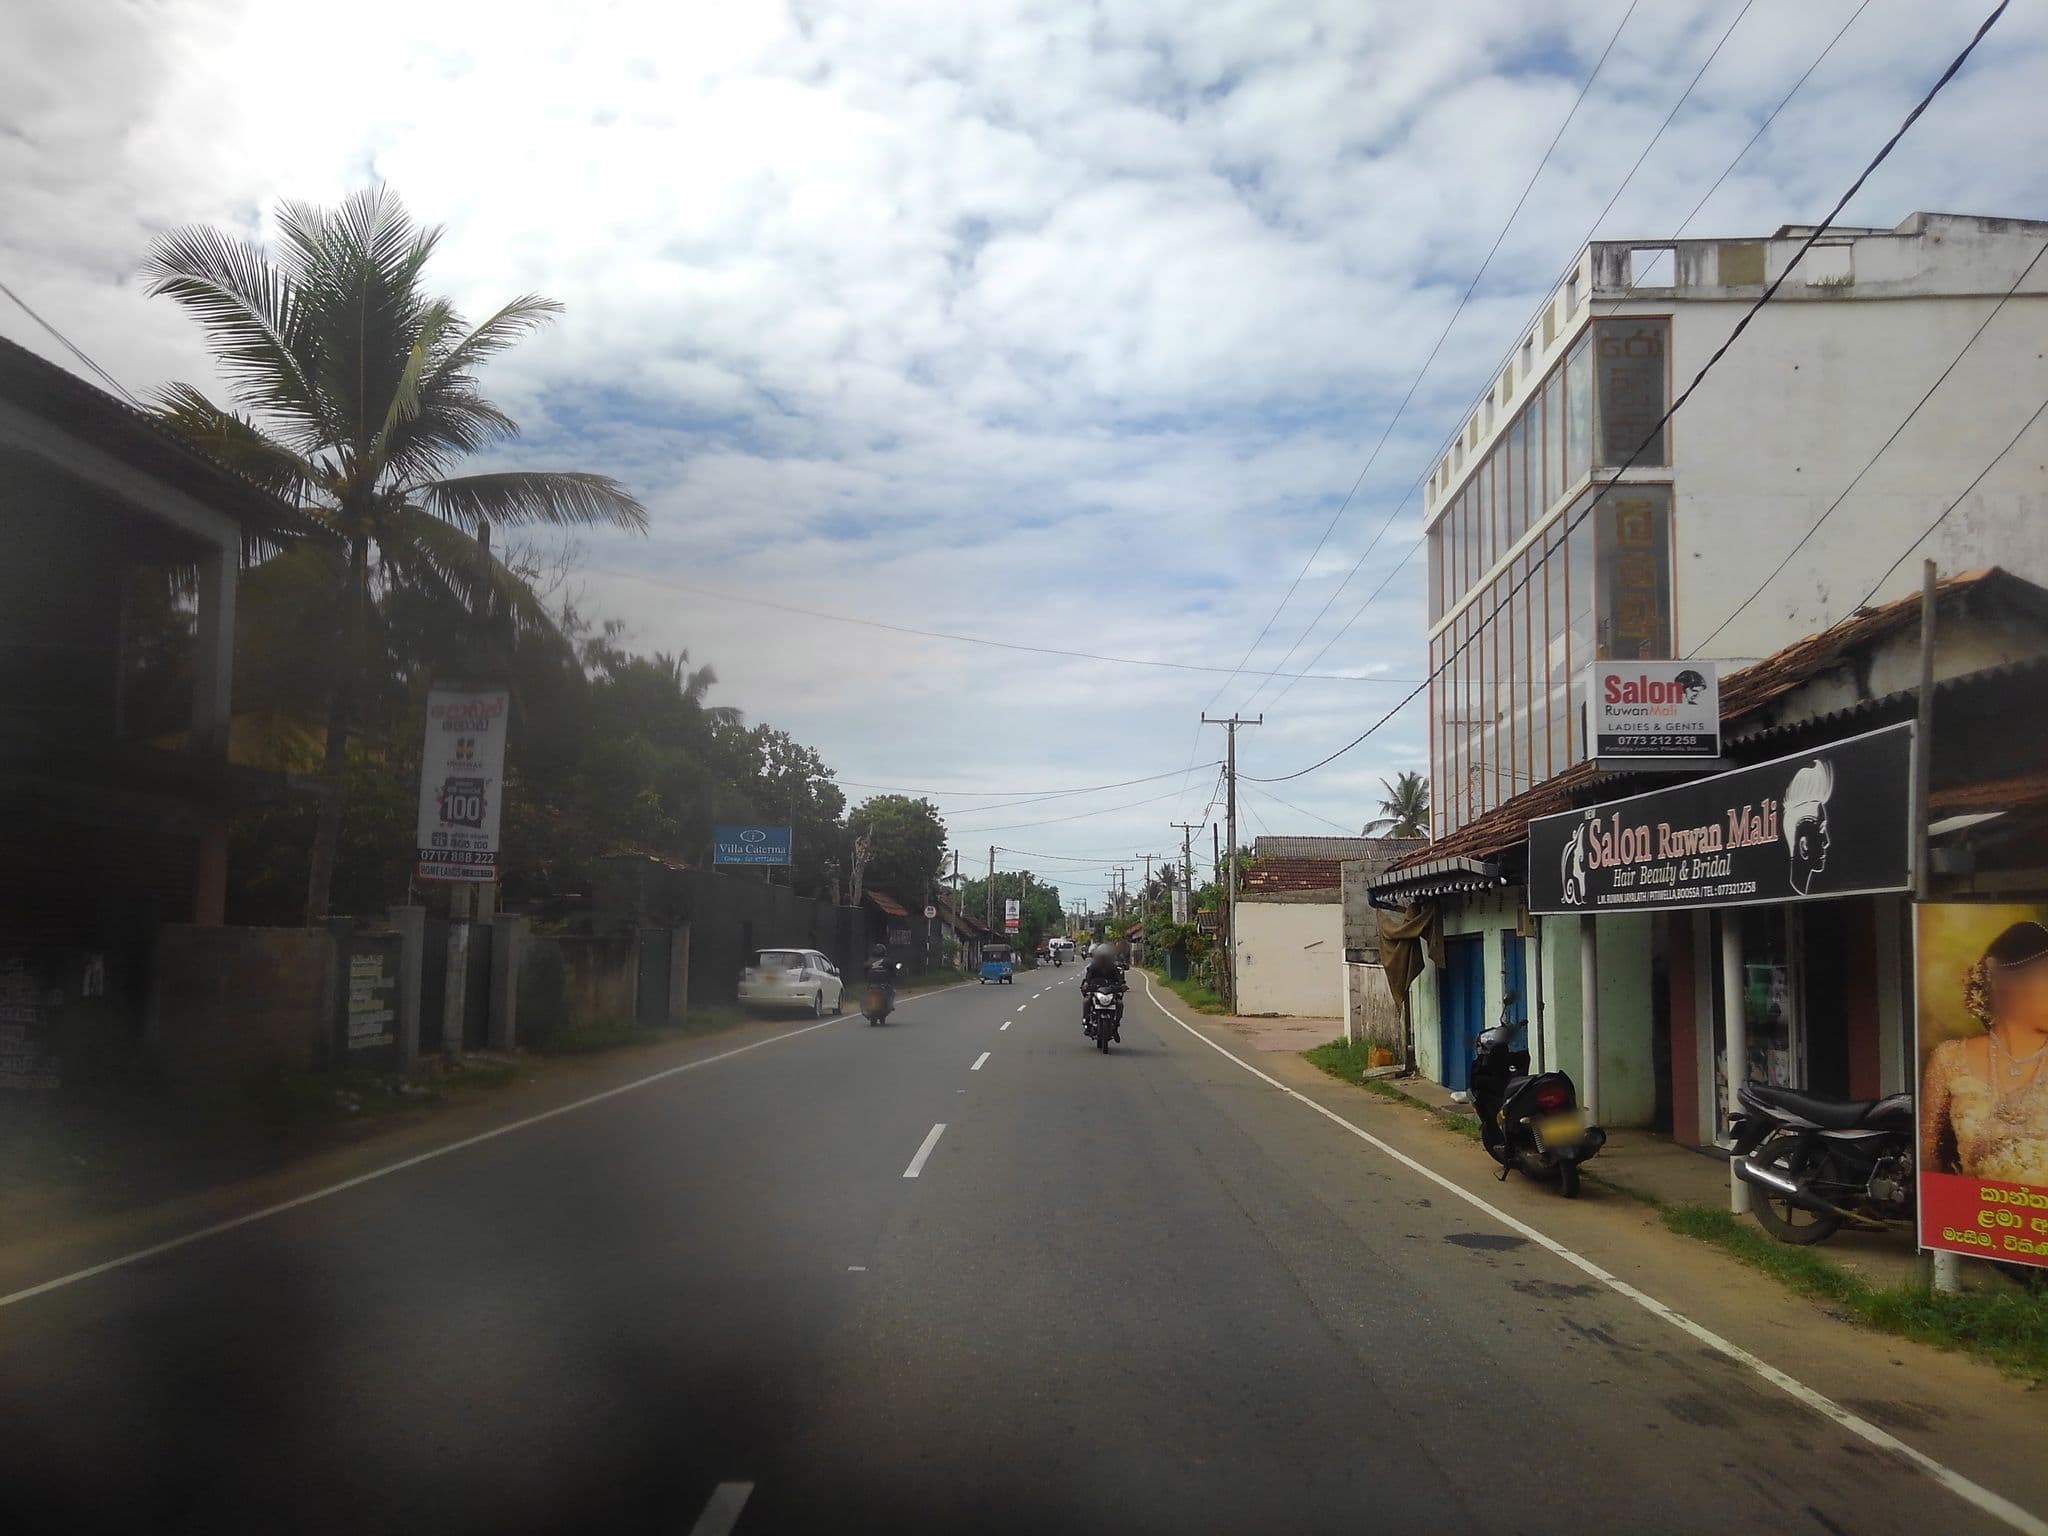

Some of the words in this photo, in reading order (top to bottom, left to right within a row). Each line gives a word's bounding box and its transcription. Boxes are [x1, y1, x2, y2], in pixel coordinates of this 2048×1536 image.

[1605, 675, 1684, 704] Salon
[1608, 723, 1650, 731] LADIES
[1653, 723, 1661, 731] &
[1665, 722, 1705, 731] GENTS
[1617, 736, 1647, 745] 0773
[1649, 736, 1673, 745] 212
[1675, 736, 1697, 745] 258
[446, 793, 481, 821] 100
[1588, 811, 1652, 869] Salon
[1656, 821, 1722, 860] Ruwan
[1726, 798, 1778, 849] Mali
[719, 843, 743, 853] Villa
[420, 850, 449, 862] 0717
[474, 853, 495, 864] 222
[1612, 868, 1636, 887] Hair
[1639, 862, 1677, 886] Beauty
[1679, 860, 1690, 881] &
[1692, 854, 1732, 879] Bridal
[1718, 881, 1756, 895] 0773212258
[1977, 1208, 2024, 1229] ළමා
